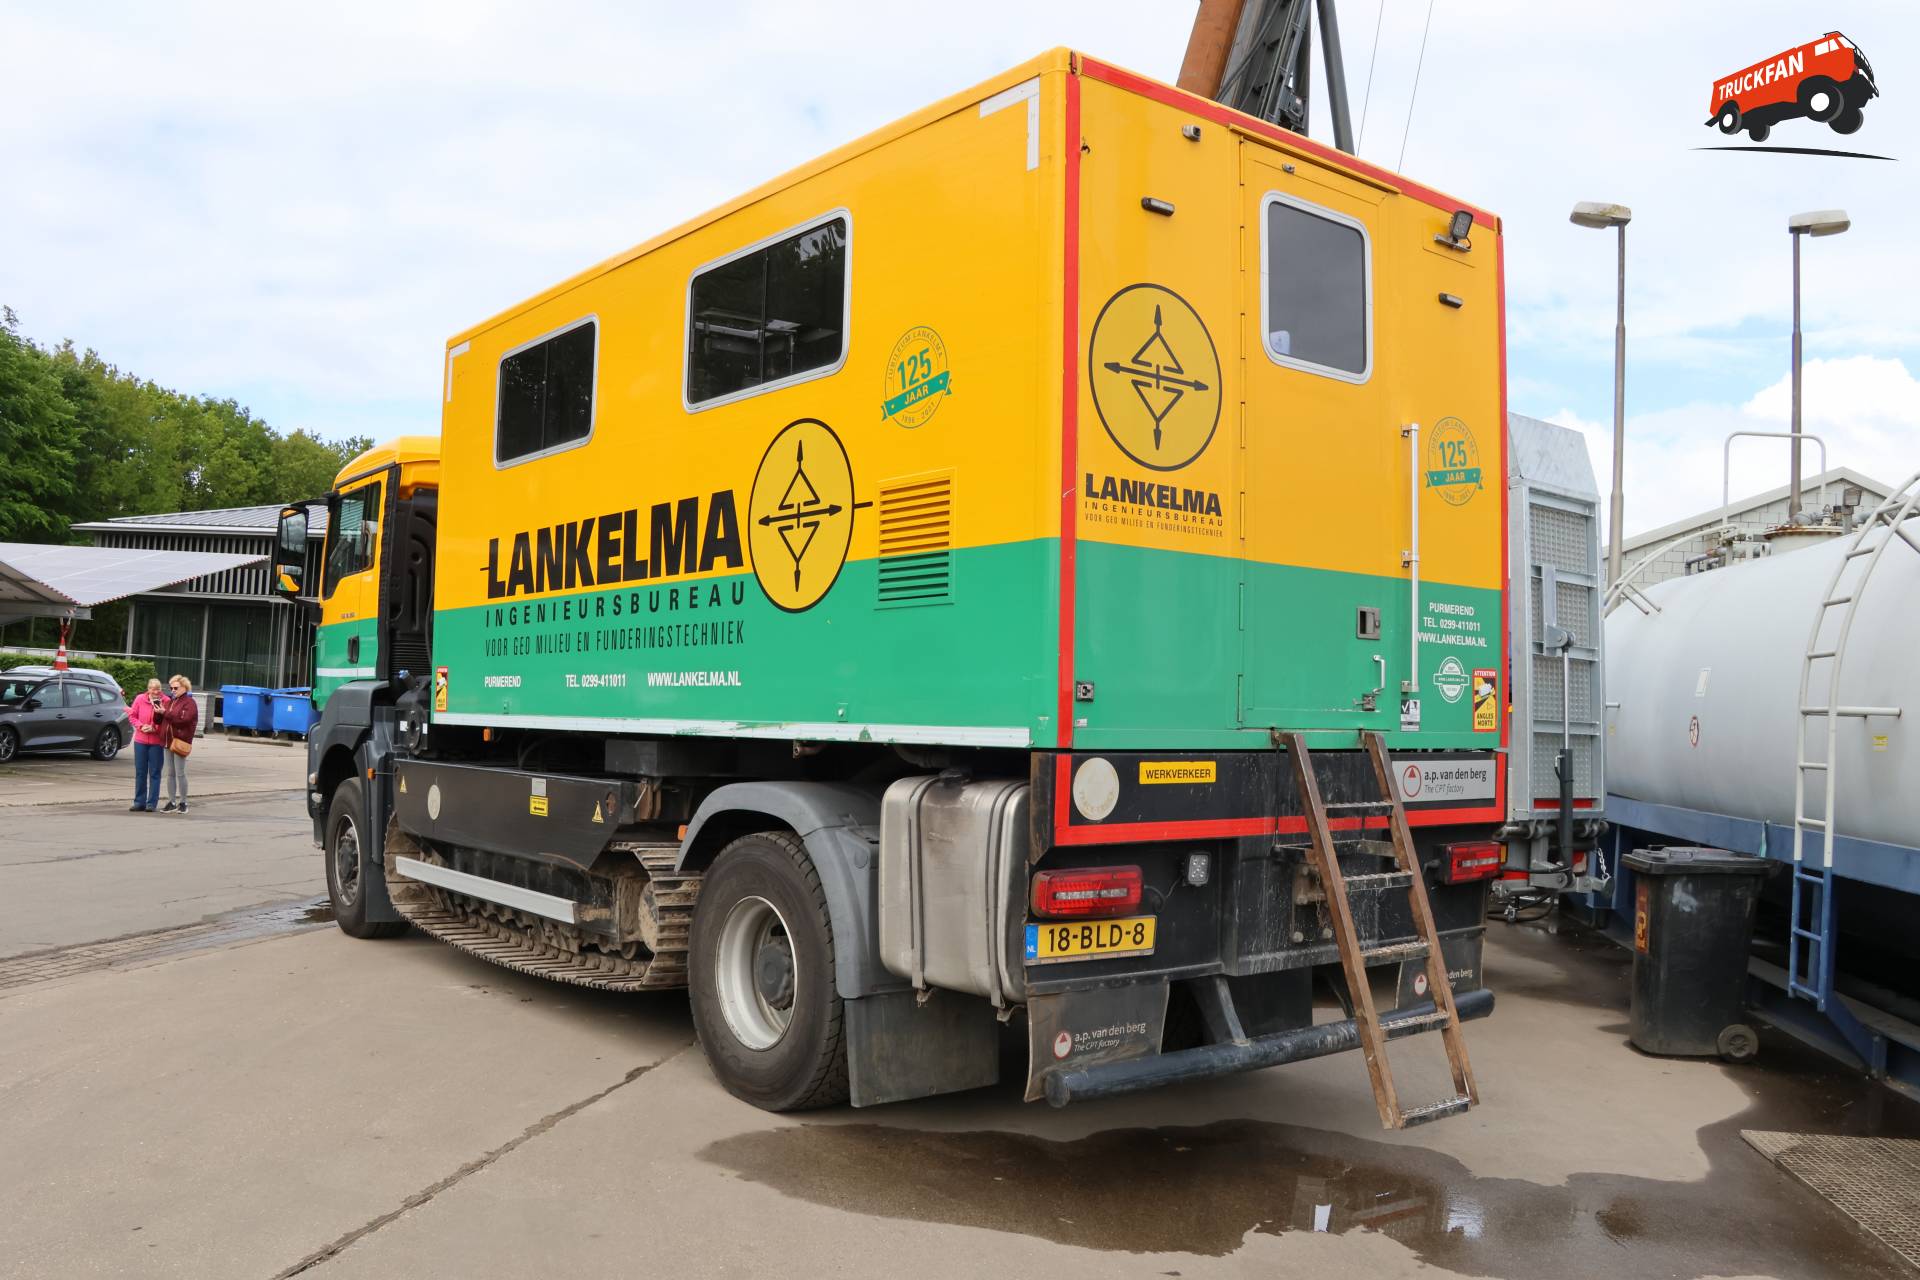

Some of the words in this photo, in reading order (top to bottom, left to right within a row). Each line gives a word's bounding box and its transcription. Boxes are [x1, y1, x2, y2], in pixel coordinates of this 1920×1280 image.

[897, 348, 932, 390] 125
[904, 384, 929, 405] JAAR
[1439, 440, 1468, 468] 125
[1446, 471, 1466, 482] JAAR
[1085, 473, 1223, 517] LANKELMA
[1085, 501, 1223, 527] INGENIEURSBUREAU
[488, 489, 744, 599] LANKELMA
[486, 581, 744, 628] INGENIEURSBUREAU
[1429, 602, 1475, 616] PURMEREND
[1439, 619, 1481, 632] 0299-411011
[485, 638, 508, 657] VOOR
[513, 636, 530, 655] GEO
[536, 632, 571, 654] MILIEU
[577, 631, 590, 652] EN
[596, 620, 744, 651] FUNDERINGSTECHNIEK
[484, 675, 522, 688] PURMEREND
[581, 673, 626, 688] 0299-411011
[647, 670, 742, 687] WWW.LANKELMA.NL
[1145, 769, 1211, 779] WERKVERKEER
[1424, 771, 1439, 783] a.p.
[1440, 771, 1453, 780] van
[1455, 768, 1468, 780] den
[1470, 768, 1487, 782] berg
[1048, 922, 1145, 952] 18-BLD-8
[1026, 945, 1036, 953] NL
[1074, 1032, 1091, 1044] a.p.
[1092, 1029, 1107, 1039] van
[1109, 1025, 1125, 1036] den
[1126, 1022, 1146, 1034] berg
